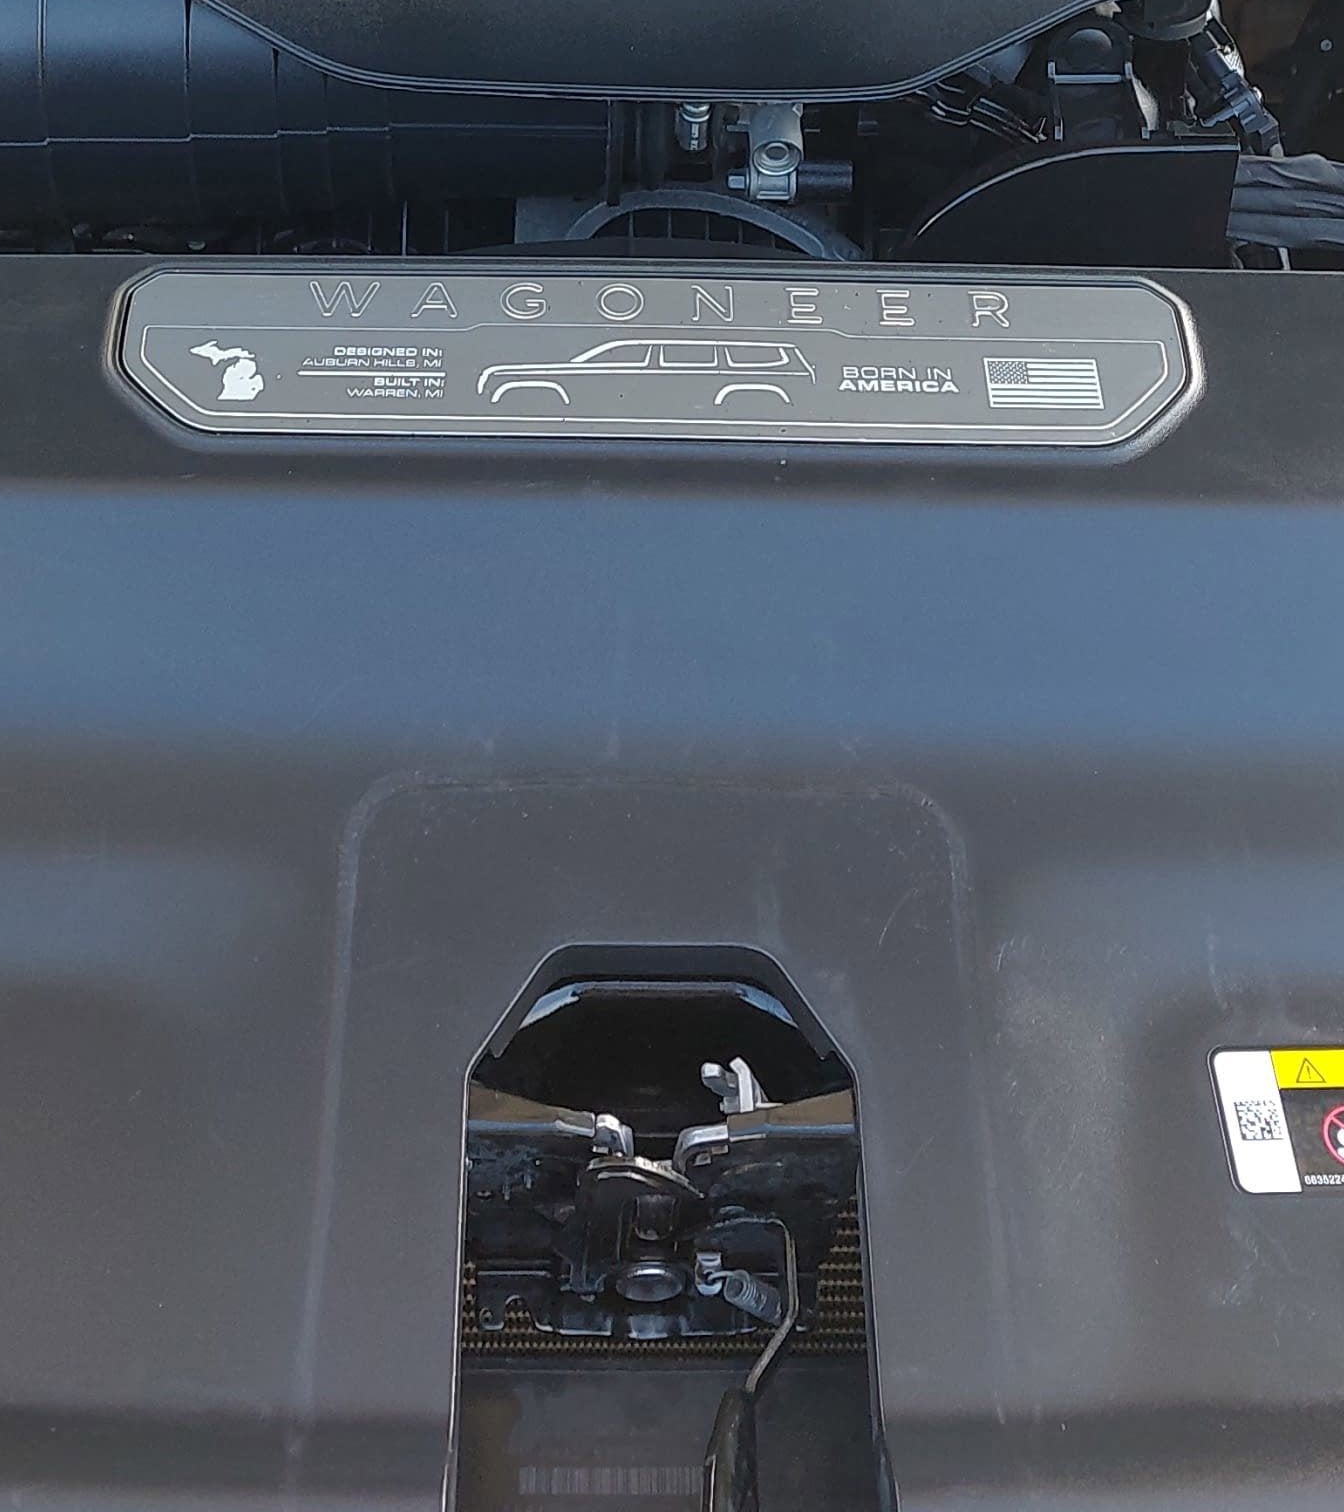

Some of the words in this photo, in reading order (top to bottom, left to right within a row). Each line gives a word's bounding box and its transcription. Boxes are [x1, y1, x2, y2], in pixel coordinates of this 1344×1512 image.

[310, 281, 1010, 327] WAGONEER
[334, 346, 417, 357] DESIGNED
[422, 348, 443, 357] IN:
[302, 357, 370, 367] AUBURN
[373, 358, 419, 368] HILLS,
[423, 359, 442, 368] MI
[842, 366, 916, 379] BORN
[927, 367, 952, 380] IN
[373, 377, 420, 387] BUILT
[424, 378, 445, 387] IN:
[839, 380, 960, 393] AMERICA
[347, 388, 421, 398] WARREN,
[425, 389, 444, 398] MI
